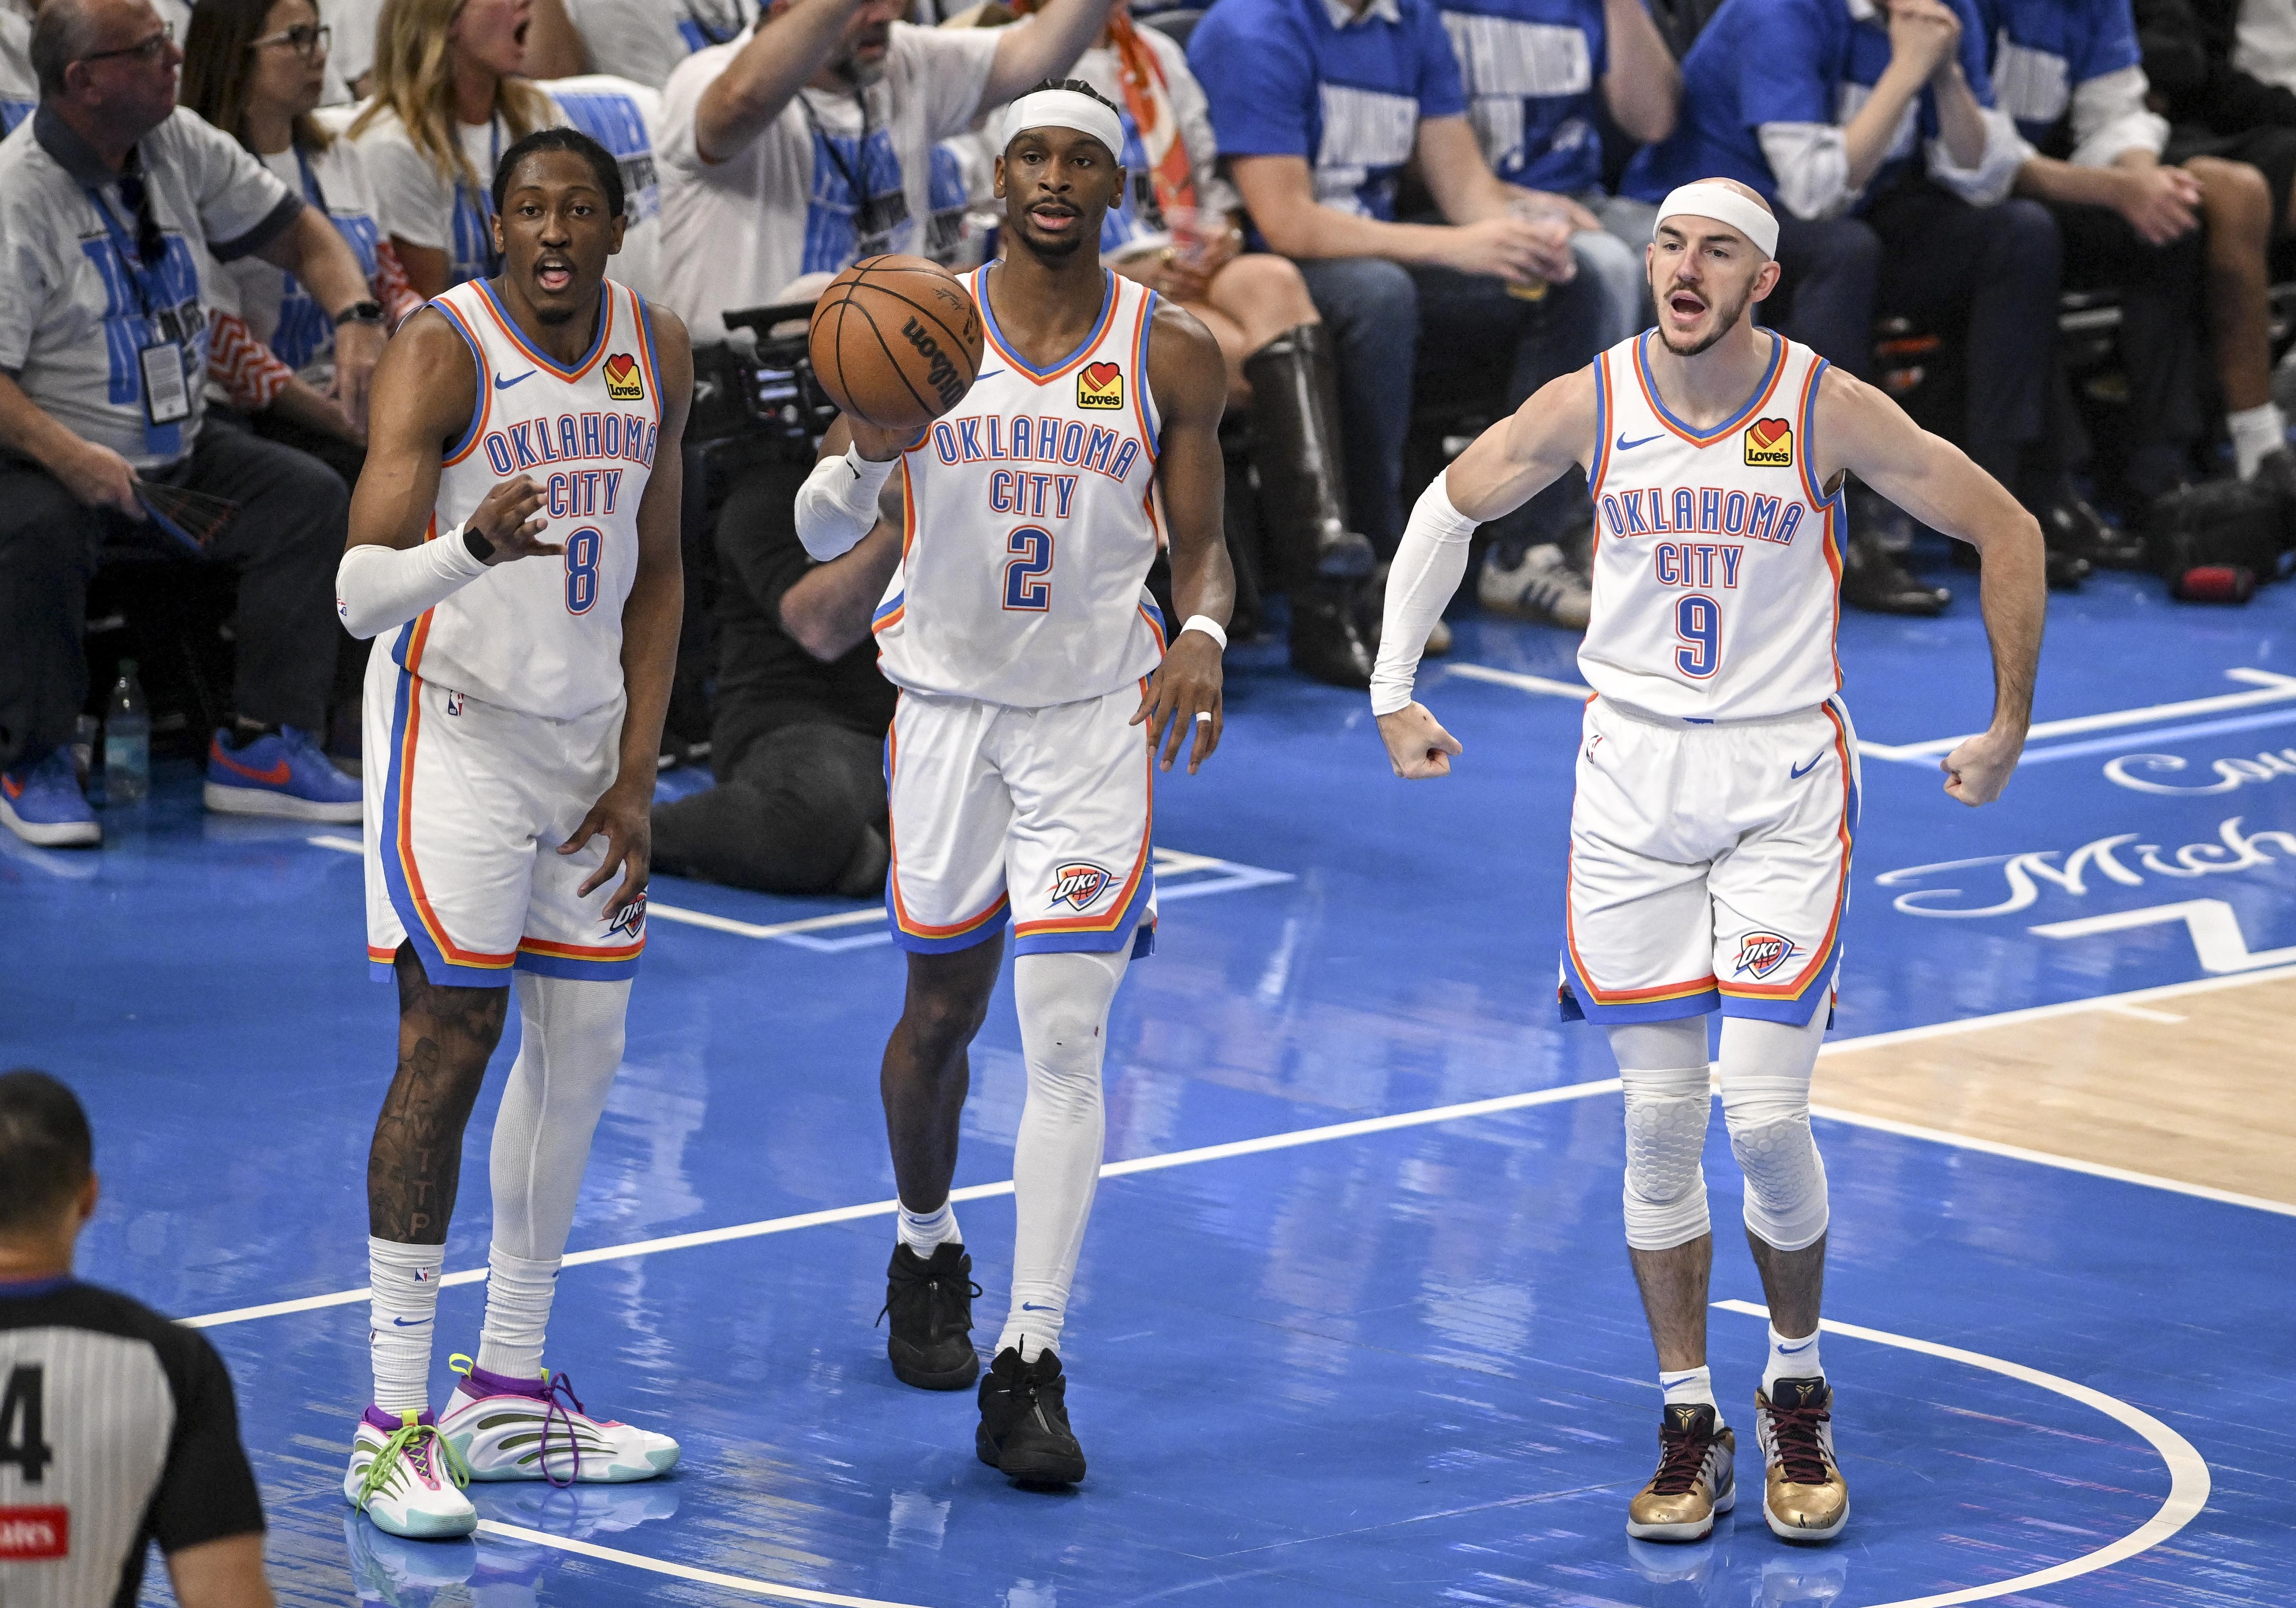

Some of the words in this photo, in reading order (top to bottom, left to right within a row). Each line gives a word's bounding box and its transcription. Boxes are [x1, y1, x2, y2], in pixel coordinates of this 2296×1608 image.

[484, 412, 658, 476] OKLAHOMA
[931, 414, 1140, 483] OKLAHOMA
[547, 468, 623, 519] CITY
[990, 470, 1078, 519] CITY
[1602, 487, 1805, 546] OKLAHOMA
[565, 526, 602, 615] 8
[1003, 525, 1054, 612] 2
[1656, 543, 1744, 588] CITY
[1675, 593, 1721, 679] 9
[1053, 873, 1099, 900] OKC
[1738, 942, 1781, 968] OKC
[0, 1363, 53, 1484] 4
